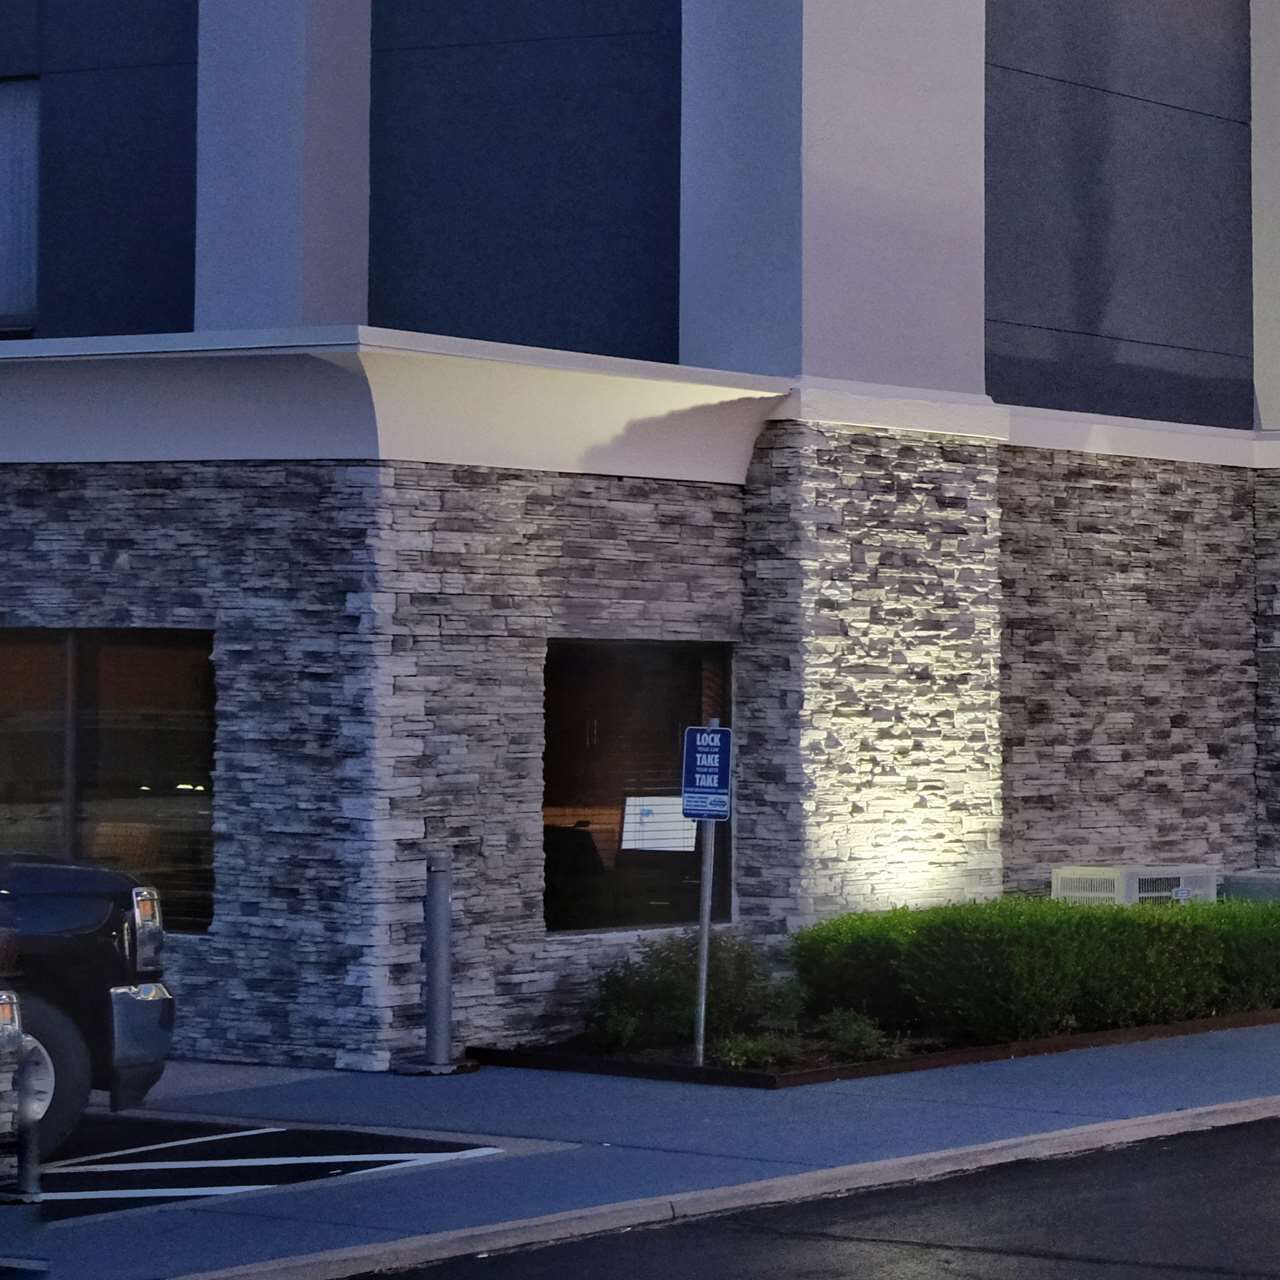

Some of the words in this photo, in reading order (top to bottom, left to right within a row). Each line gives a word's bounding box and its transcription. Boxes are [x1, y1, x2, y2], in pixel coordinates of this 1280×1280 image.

[696, 733, 721, 746] LOCK
[696, 753, 720, 766] TAKE
[695, 773, 719, 787] TAKE
